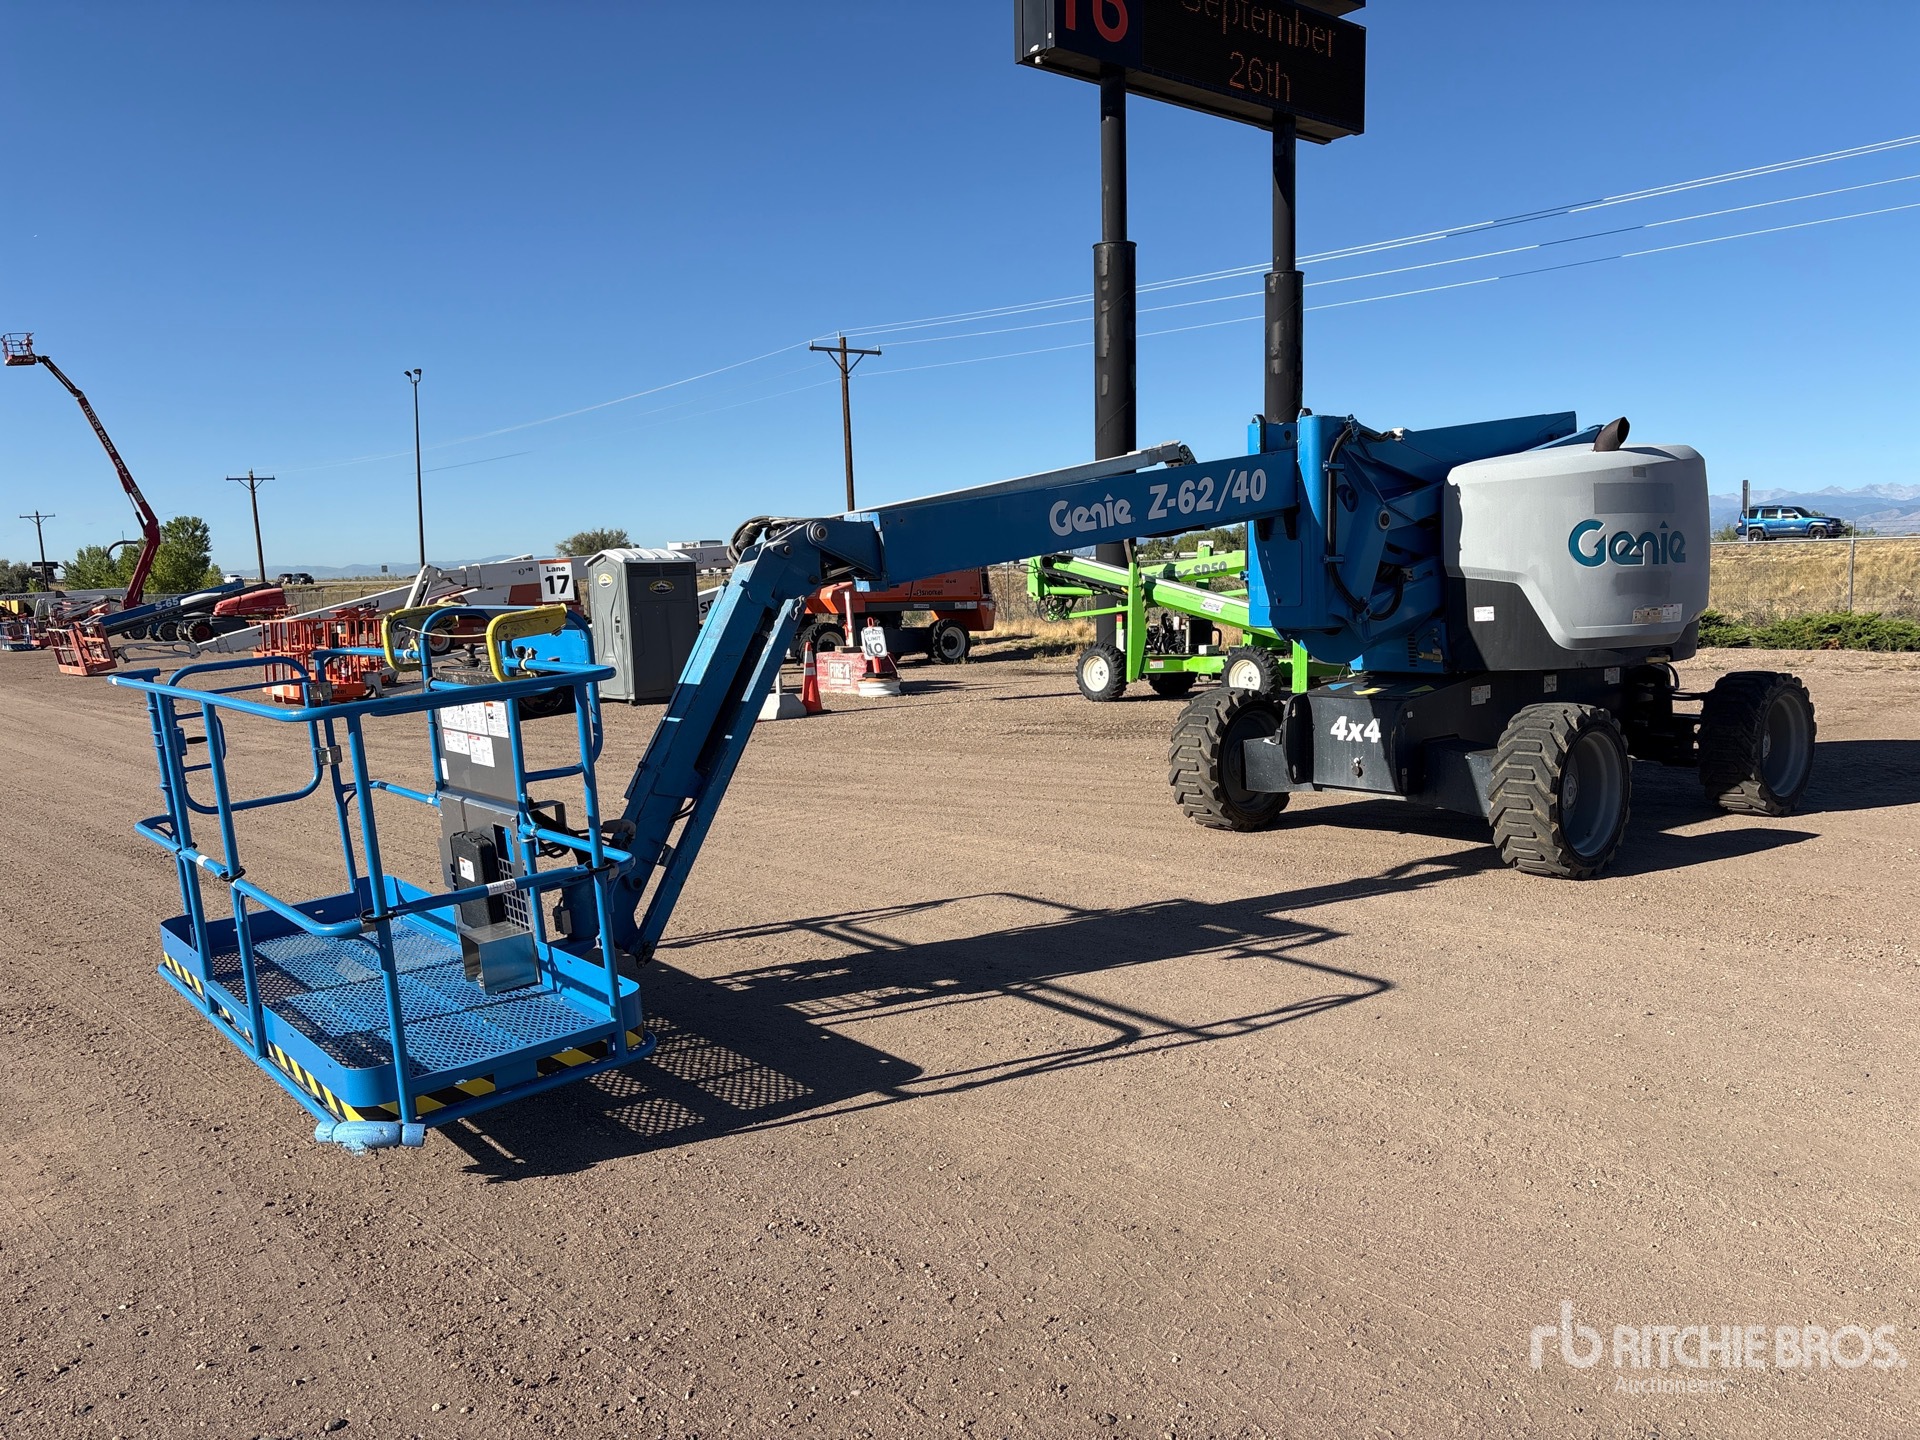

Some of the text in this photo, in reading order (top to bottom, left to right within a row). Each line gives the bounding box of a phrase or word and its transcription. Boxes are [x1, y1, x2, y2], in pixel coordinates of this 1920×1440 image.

[1229, 51, 1290, 101] 26th
[1049, 468, 1267, 537] Genie Z-62/40
[1568, 519, 1686, 568] Genie
[546, 565, 566, 573] Lane
[1193, 560, 1227, 577] SD50
[544, 574, 570, 595] 17
[154, 597, 180, 611] S-65
[867, 642, 884, 655] 10
[1330, 715, 1382, 744] 4x4
